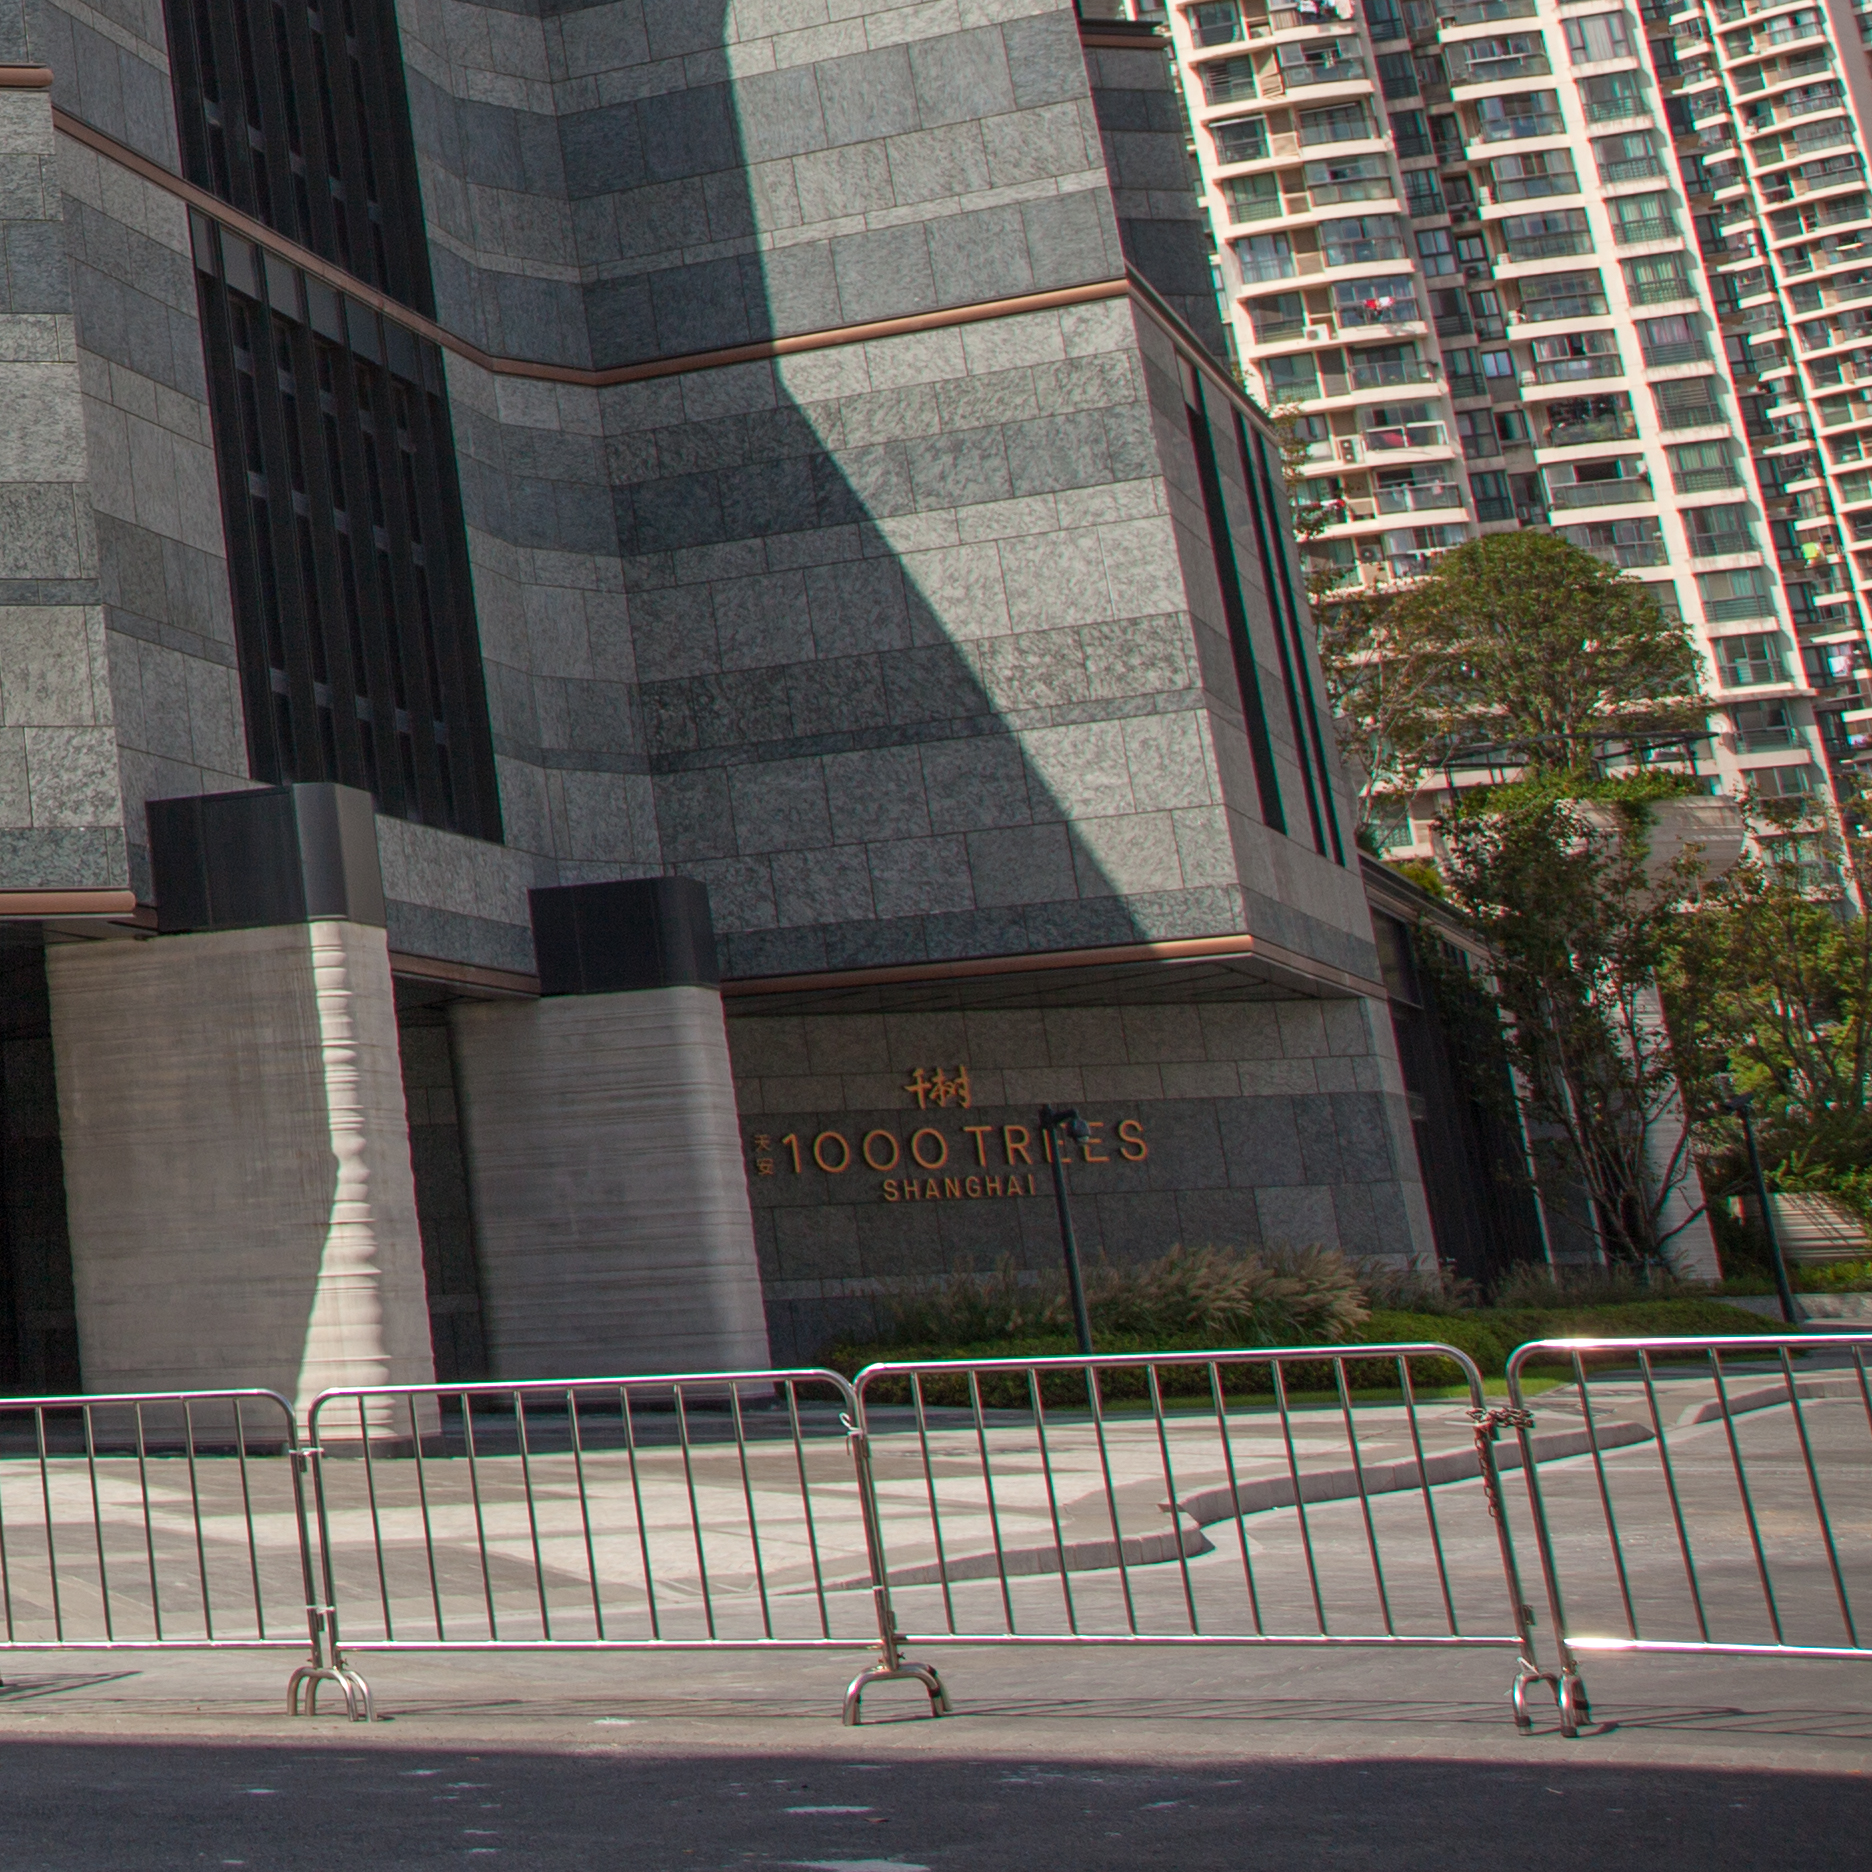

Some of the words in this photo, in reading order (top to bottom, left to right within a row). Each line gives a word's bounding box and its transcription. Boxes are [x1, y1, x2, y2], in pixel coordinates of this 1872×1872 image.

[904, 1064, 972, 1110] 千树
[754, 1133, 774, 1176] 天安
[781, 1128, 950, 1174] 1000
[963, 1119, 1149, 1168] TREES
[883, 1174, 1036, 1202] SHANGHAI
